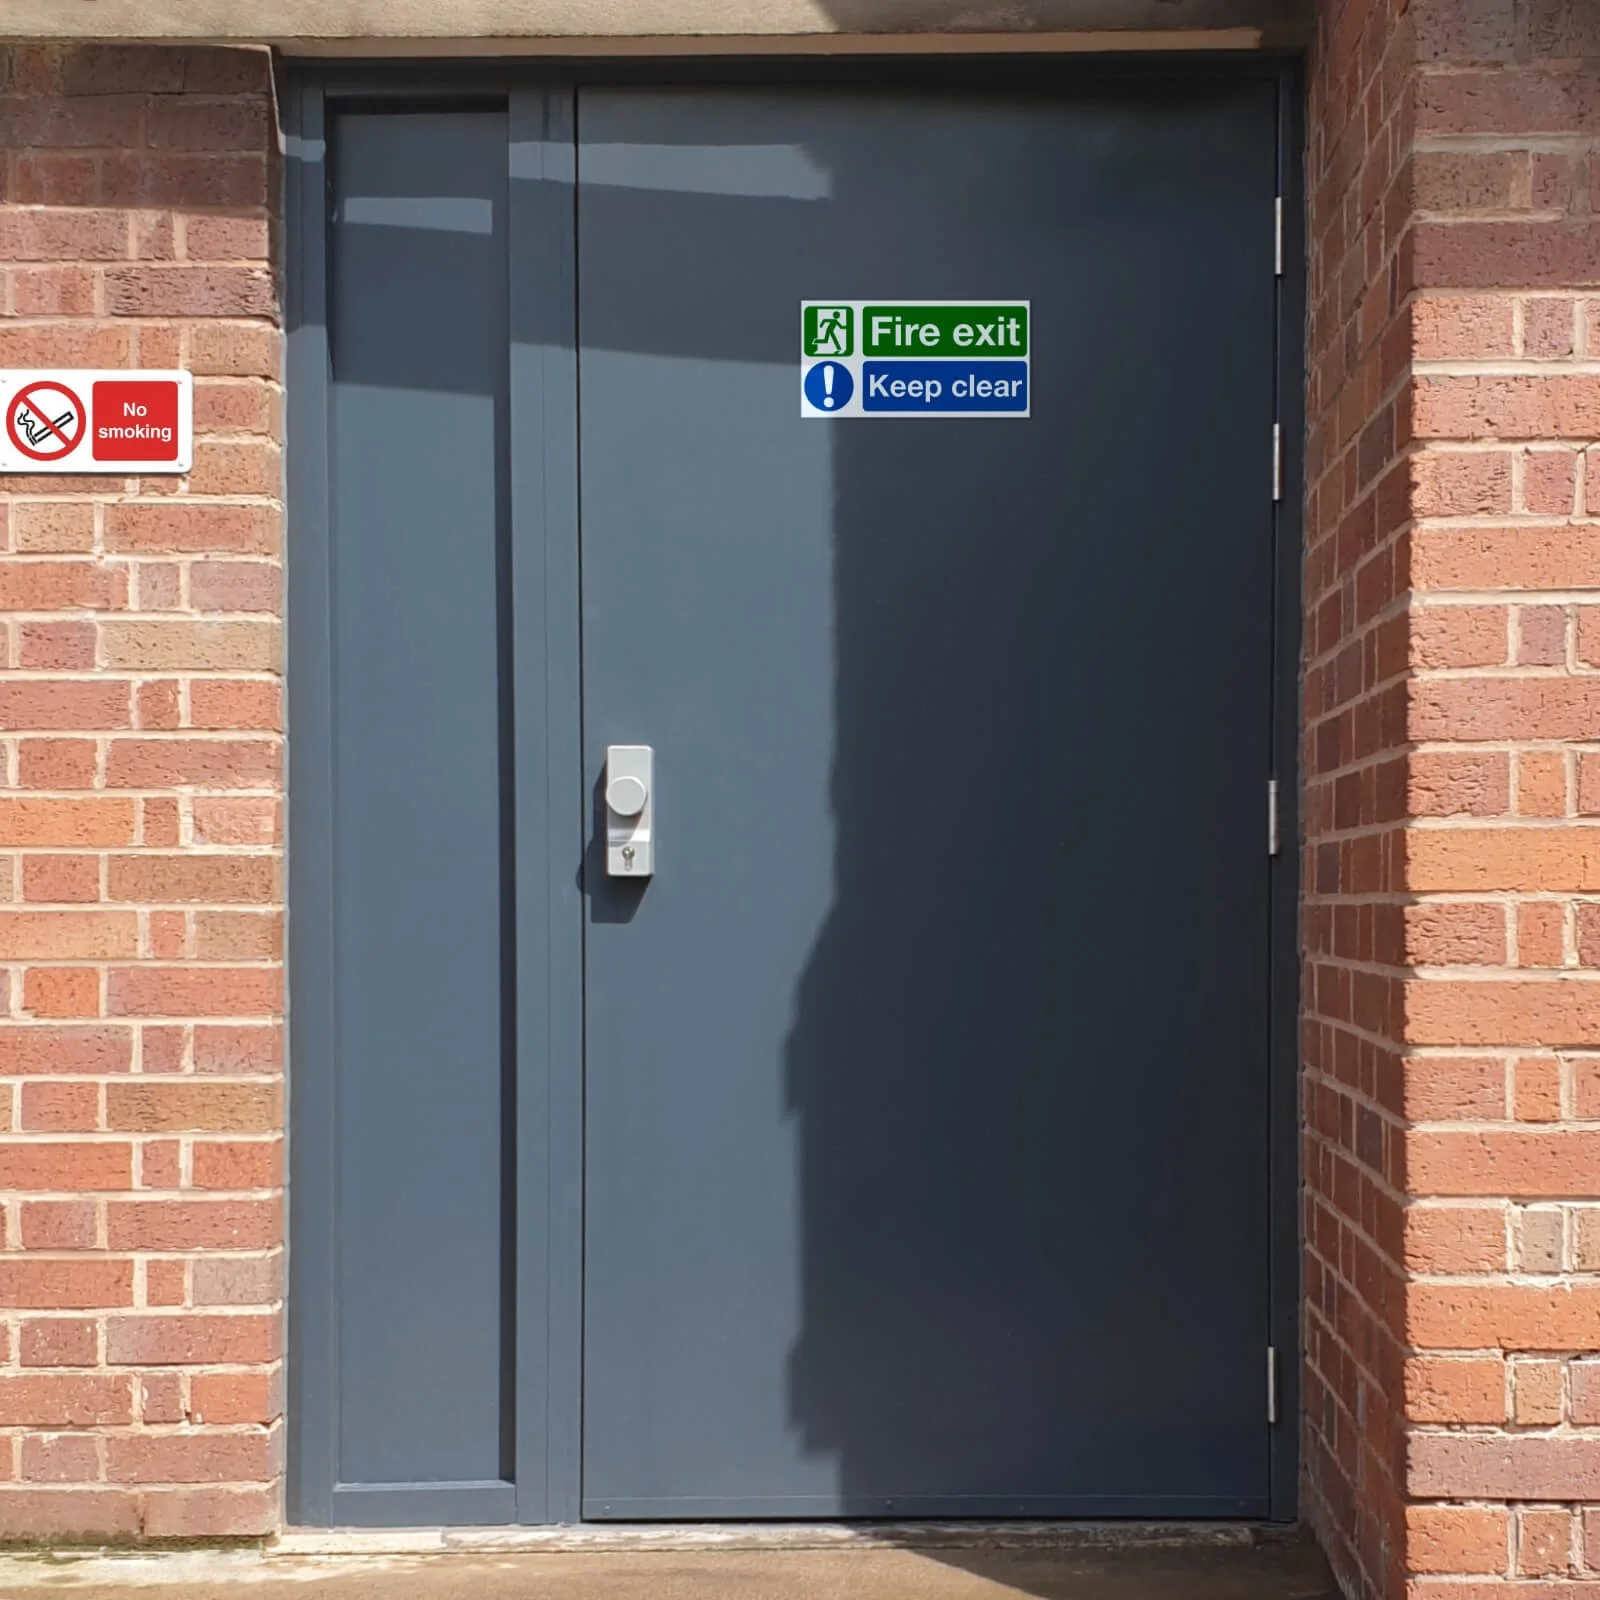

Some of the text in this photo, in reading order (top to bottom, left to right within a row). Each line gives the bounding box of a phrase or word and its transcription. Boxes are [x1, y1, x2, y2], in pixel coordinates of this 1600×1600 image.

[871, 316, 1021, 346] Fire exit
[869, 374, 1022, 403] Keep clear
[123, 402, 147, 417] No
[98, 424, 172, 442] smoking
